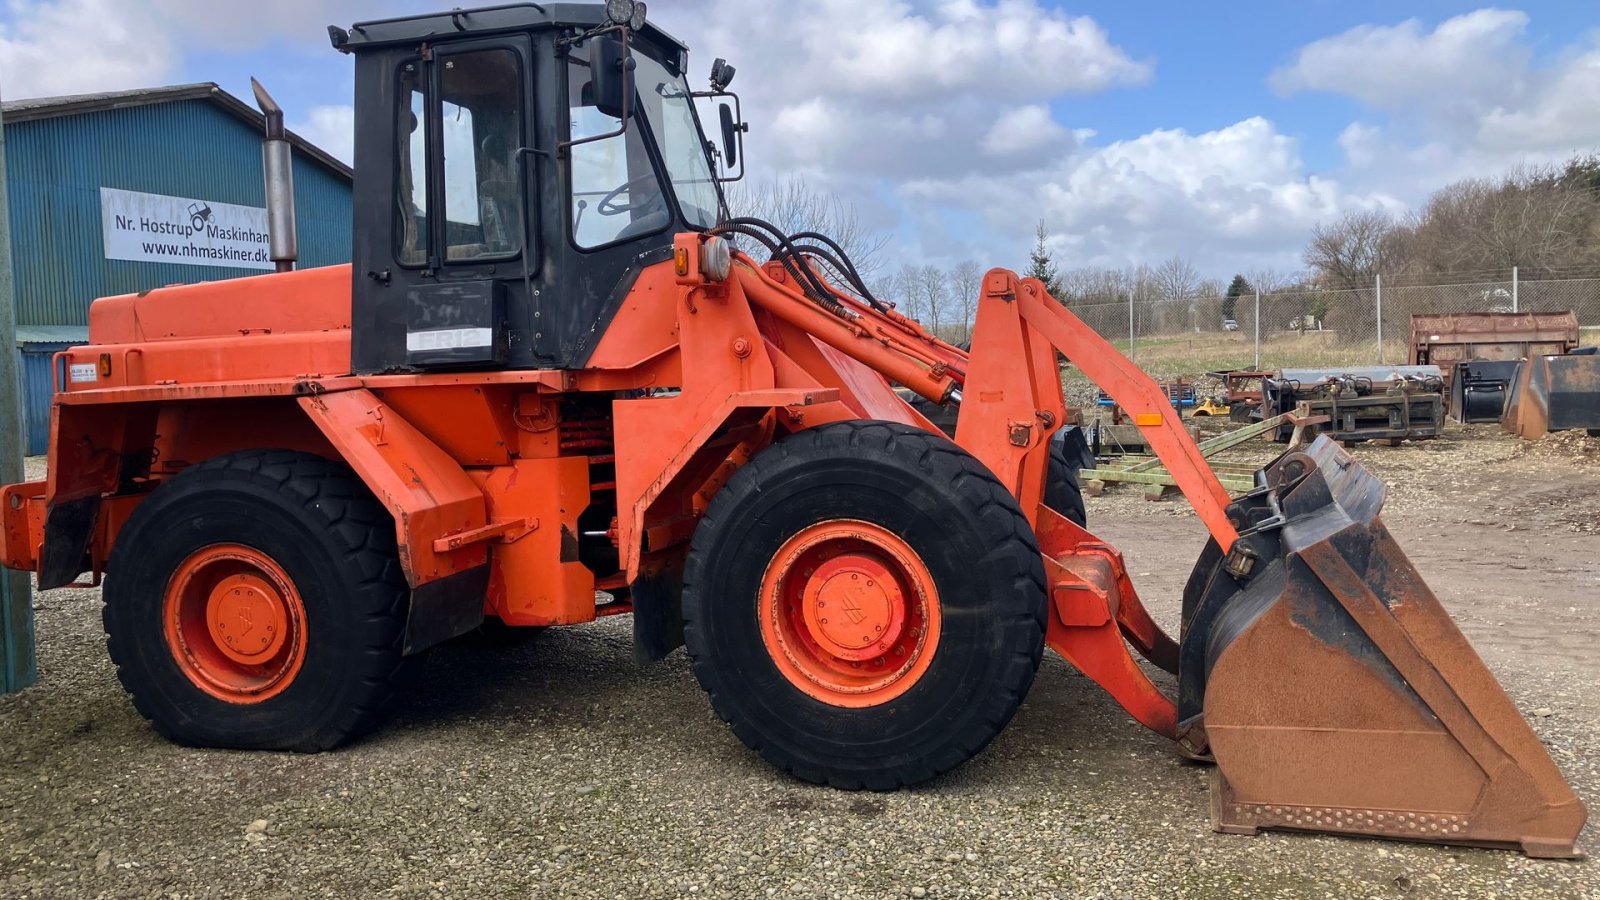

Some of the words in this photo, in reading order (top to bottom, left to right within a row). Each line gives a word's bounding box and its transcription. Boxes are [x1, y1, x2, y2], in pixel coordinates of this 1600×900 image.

[115, 214, 136, 231] Nr.
[140, 217, 193, 240] Hostrup
[142, 242, 268, 263] www.nhmaskiner.dk
[418, 330, 480, 348] FR12
